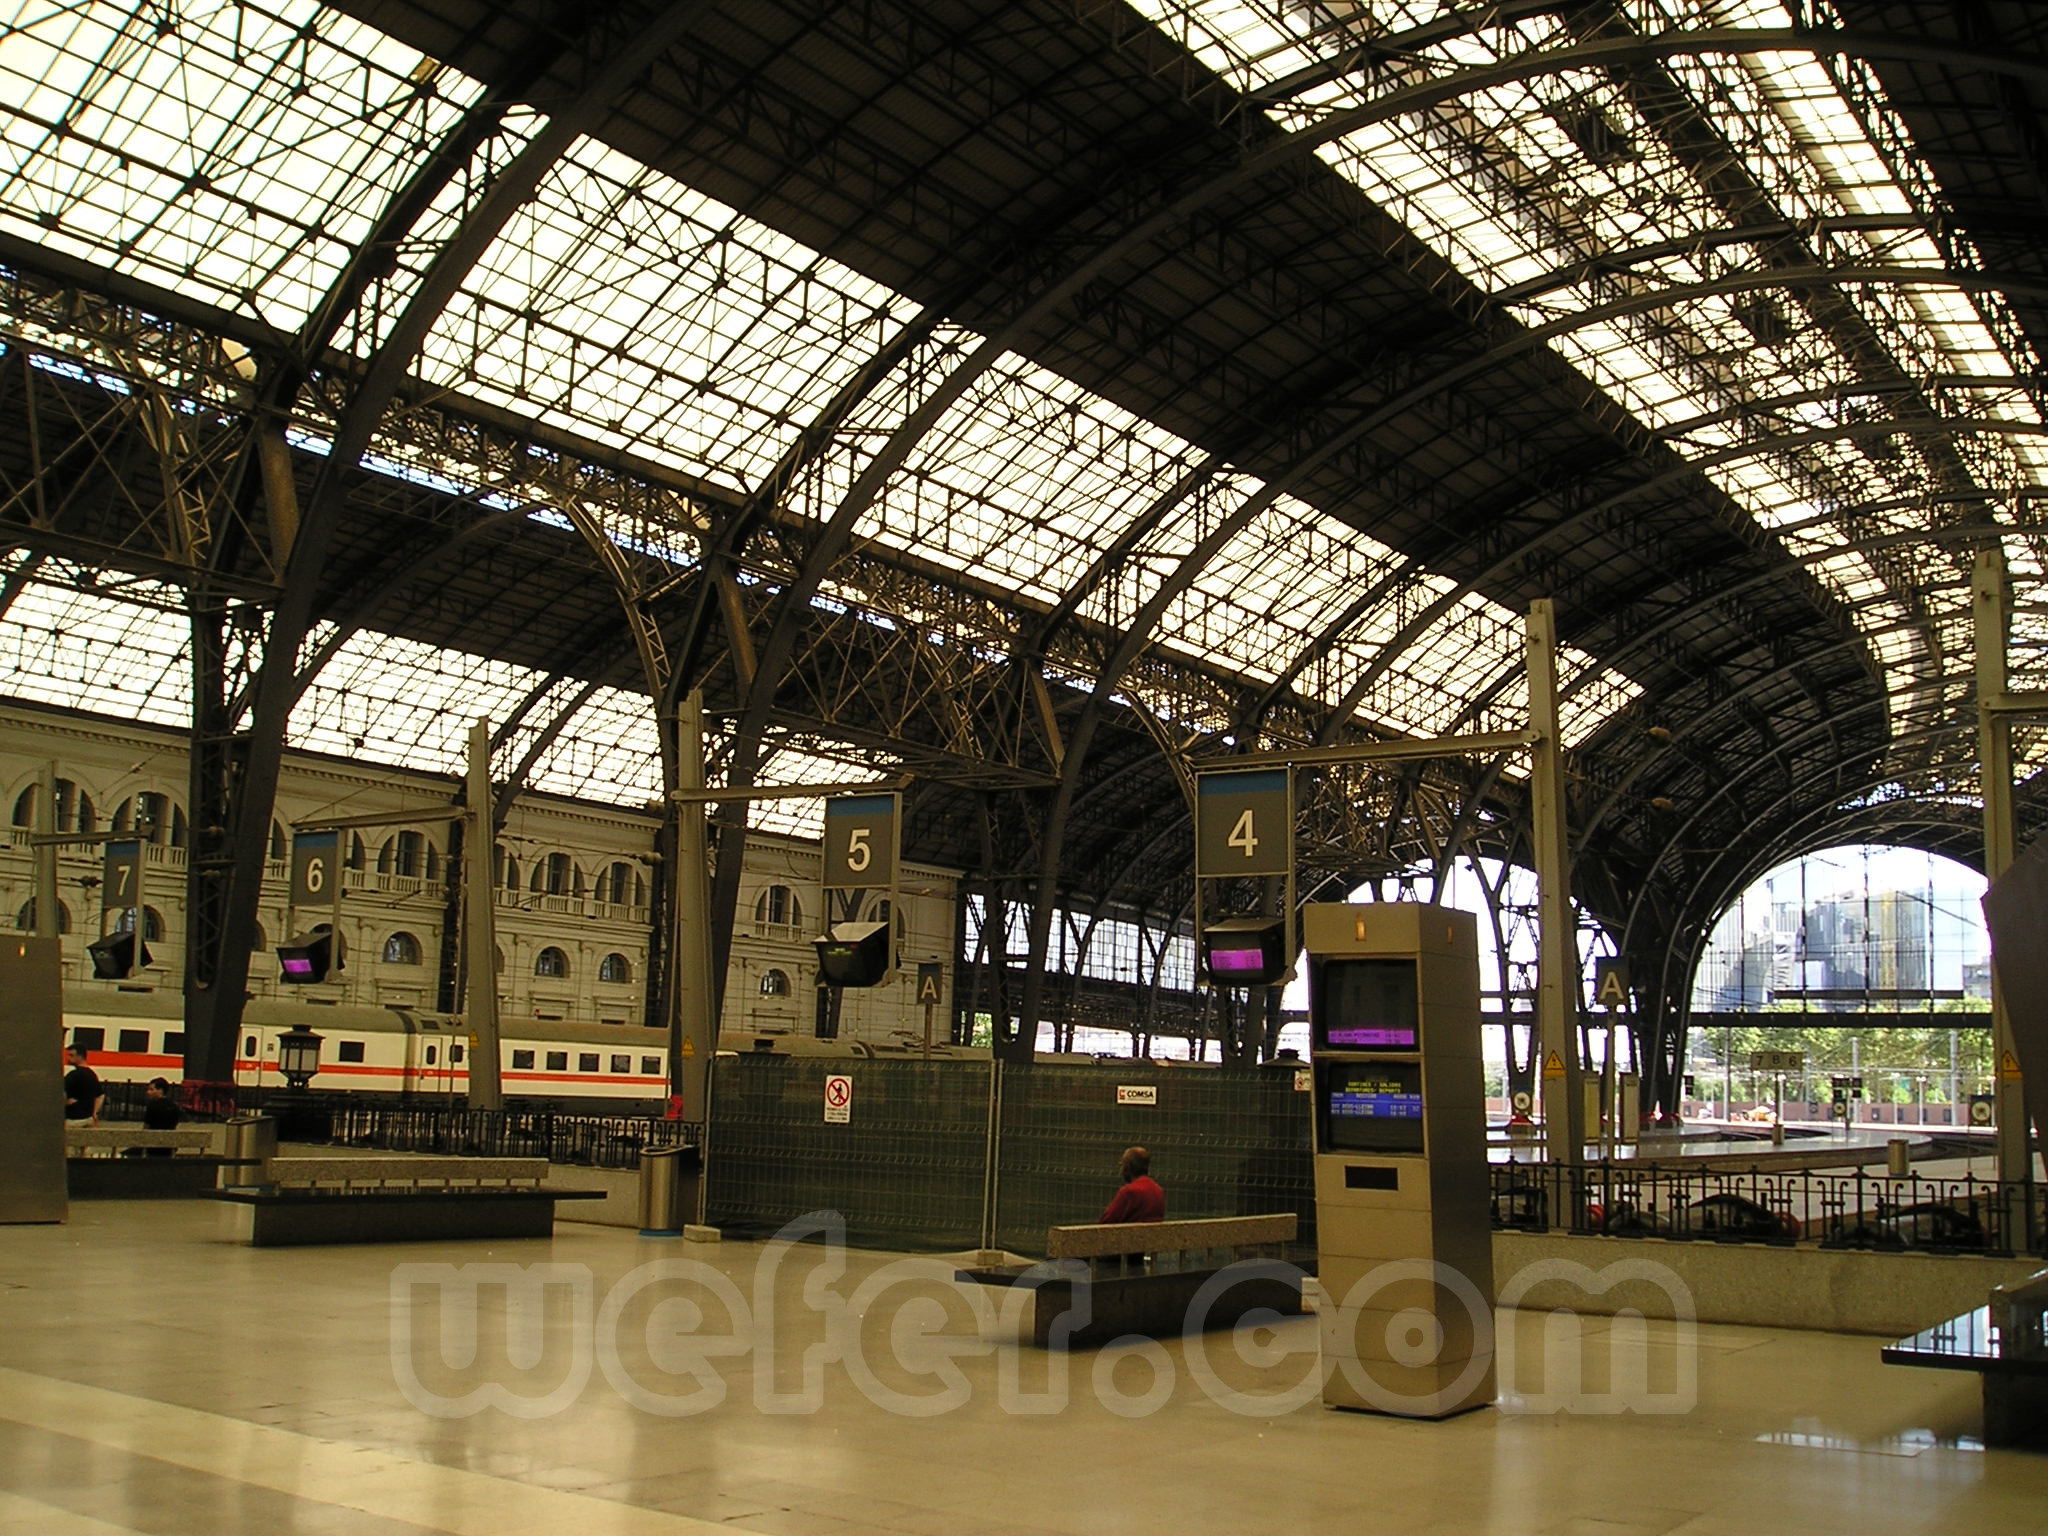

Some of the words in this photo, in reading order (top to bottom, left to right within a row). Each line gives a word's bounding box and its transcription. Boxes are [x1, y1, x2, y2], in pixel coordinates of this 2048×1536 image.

[1228, 809, 1259, 857] 4
[847, 828, 871, 872] 5
[117, 864, 132, 897] 7
[306, 857, 325, 893] 6
[920, 975, 938, 1000] A
[1599, 971, 1625, 1000] A
[1755, 1055, 1764, 1066] 7
[1788, 1055, 1797, 1067] 6
[1127, 1090, 1155, 1099] COMSA
